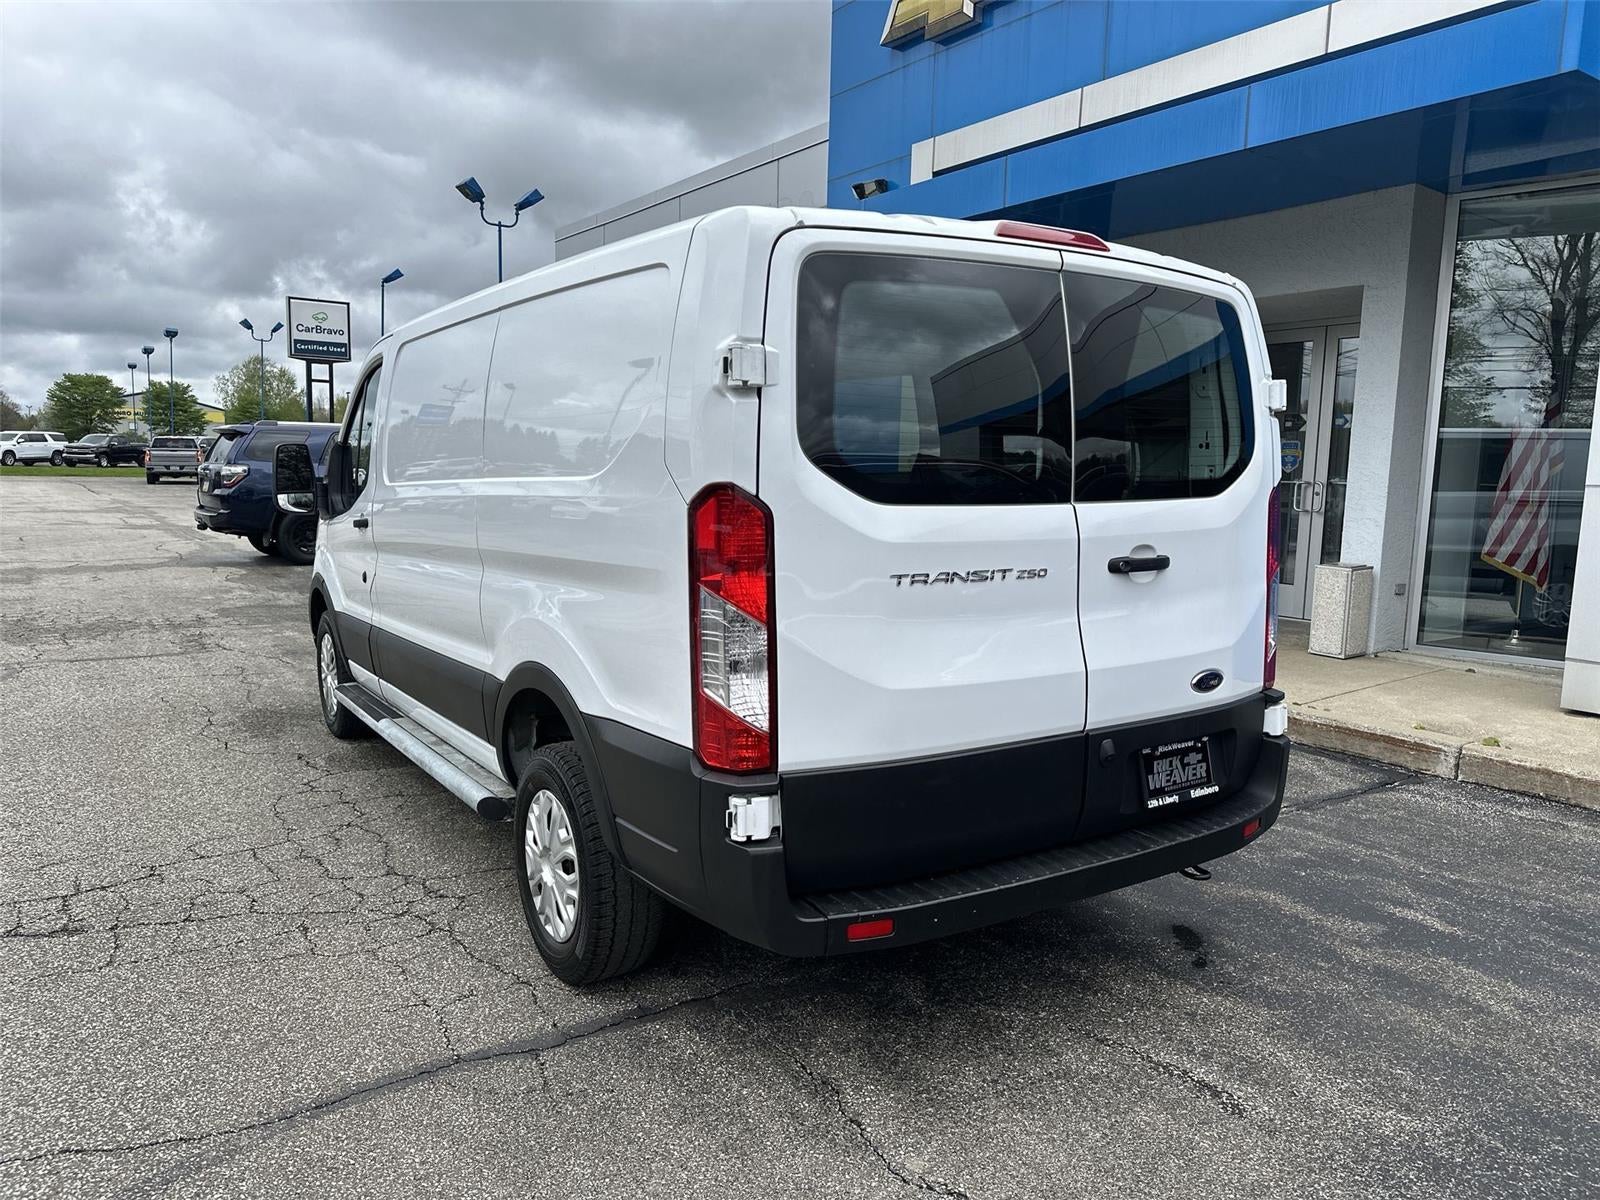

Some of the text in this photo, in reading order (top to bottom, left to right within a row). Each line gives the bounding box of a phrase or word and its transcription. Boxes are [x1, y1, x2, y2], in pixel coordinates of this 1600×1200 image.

[296, 323, 345, 336] CarBravo
[296, 343, 327, 351] Certified
[889, 568, 1048, 588] TRANSIT 250
[1153, 755, 1181, 774] RICK
[1147, 762, 1207, 790] WEAVER
[1190, 785, 1219, 798] Edinboro
[1147, 798, 1158, 808] 12th
[1163, 794, 1179, 803] Liberty
